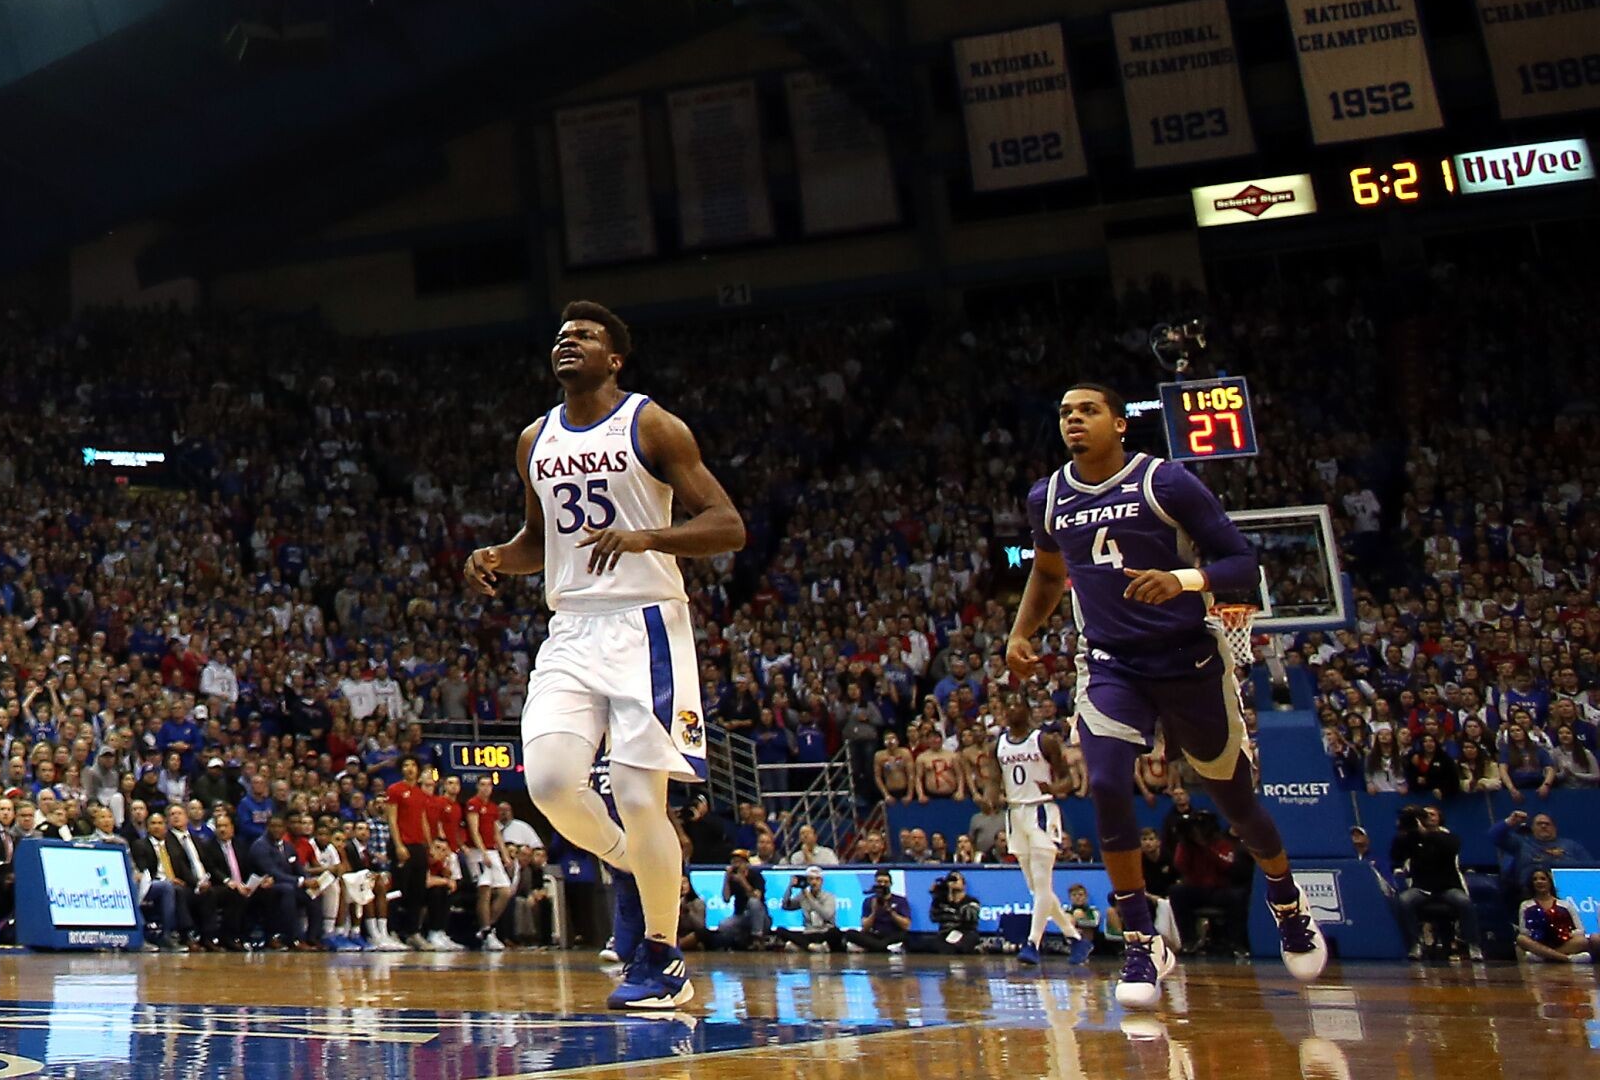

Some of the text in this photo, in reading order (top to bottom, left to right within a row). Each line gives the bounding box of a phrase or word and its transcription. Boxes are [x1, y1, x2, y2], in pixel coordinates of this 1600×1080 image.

[1129, 26, 1220, 53] NATIONAL
[1298, 20, 1418, 53] CHAMPIONS
[970, 51, 1055, 78] NATIONAL
[1122, 47, 1234, 79] CHAMPIONS
[962, 73, 1067, 104] CHAMPIONS
[1329, 82, 1414, 120] 1952
[1150, 108, 1228, 146] 1923
[989, 132, 1063, 168] 1922
[1182, 387, 1243, 411] 11:05
[1188, 412, 1242, 453] 27
[536, 450, 627, 481] KANSAS
[552, 478, 616, 534] 35
[1055, 503, 1140, 530] K-STATE
[1091, 526, 1123, 569] 4
[461, 745, 510, 768] 11:06
[1000, 752, 1041, 765] KANSAS
[1013, 765, 1026, 786] 0
[1263, 783, 1330, 796] ROCKET
[68, 932, 99, 944] ROCKET
